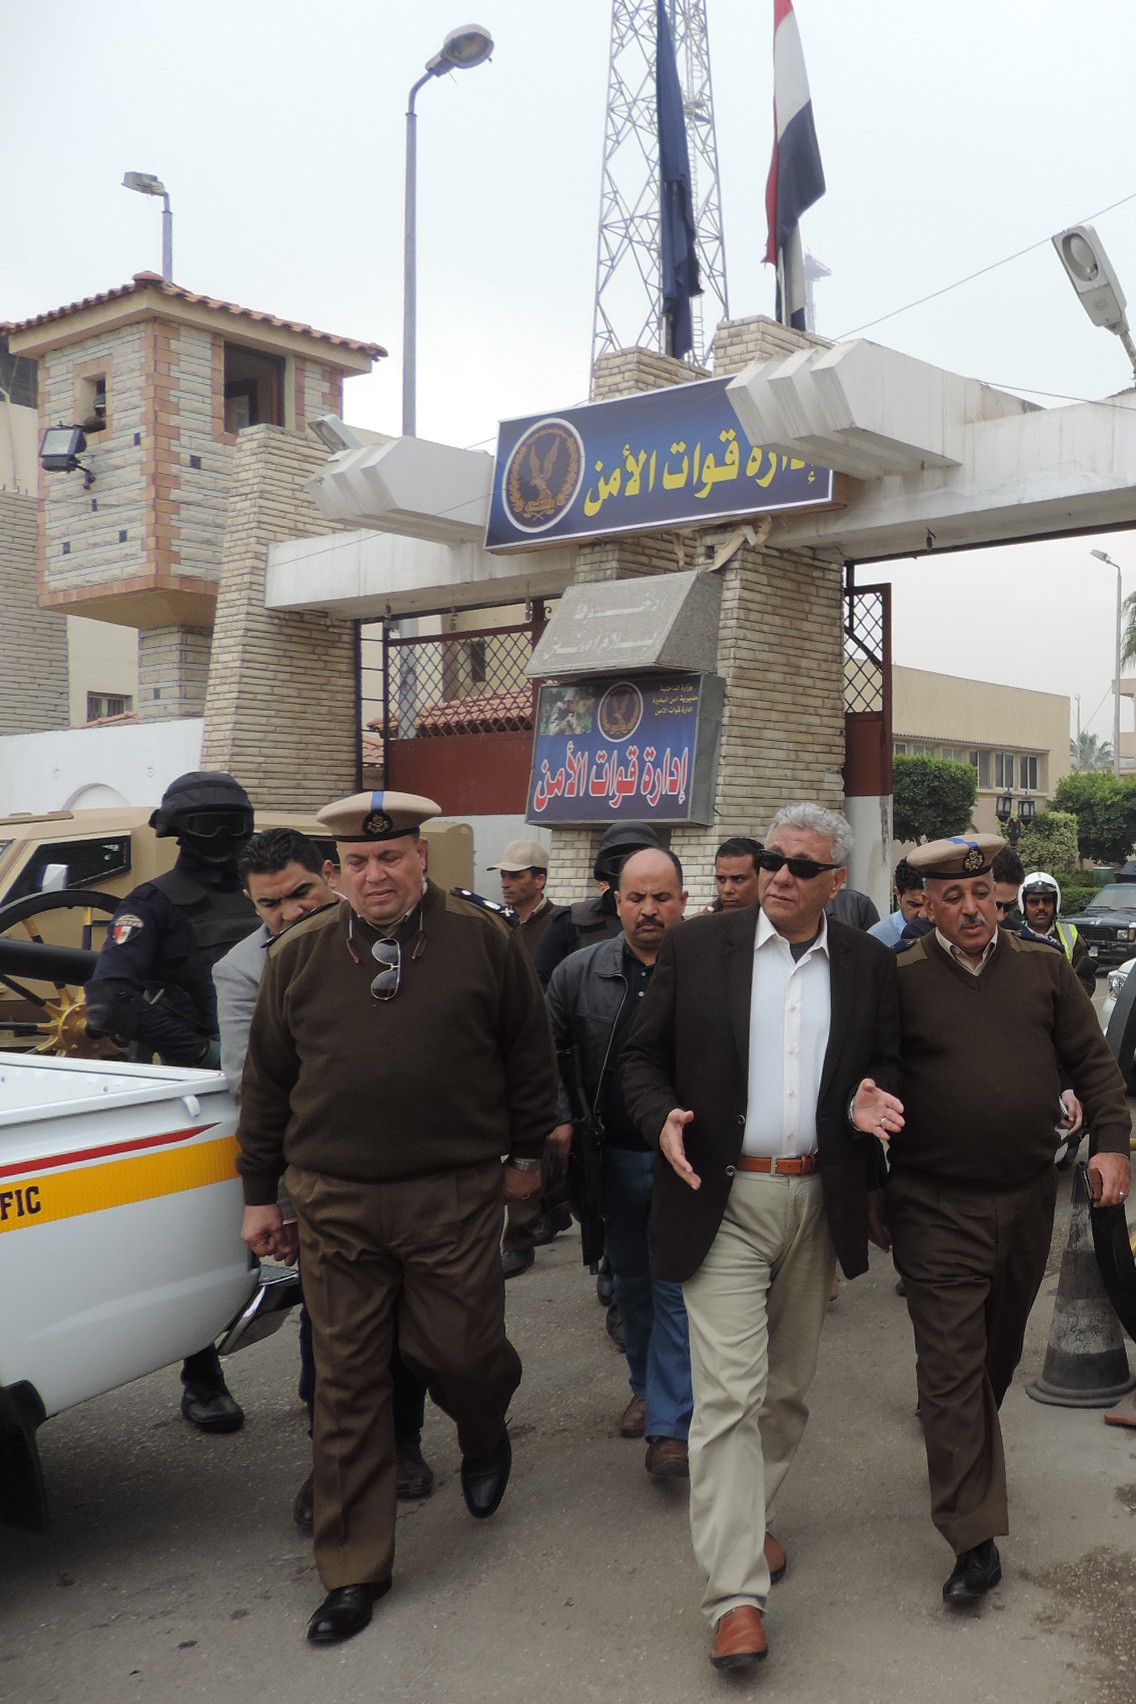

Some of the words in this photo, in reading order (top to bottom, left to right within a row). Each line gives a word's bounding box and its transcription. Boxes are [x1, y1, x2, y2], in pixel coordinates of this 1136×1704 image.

[584, 443, 657, 517] الأمن
[662, 428, 740, 498] قوات
[534, 740, 588, 812] الأمن
[589, 745, 639, 808] قوات
[641, 746, 689, 807] إدارة
[0, 1186, 41, 1220] FIC
